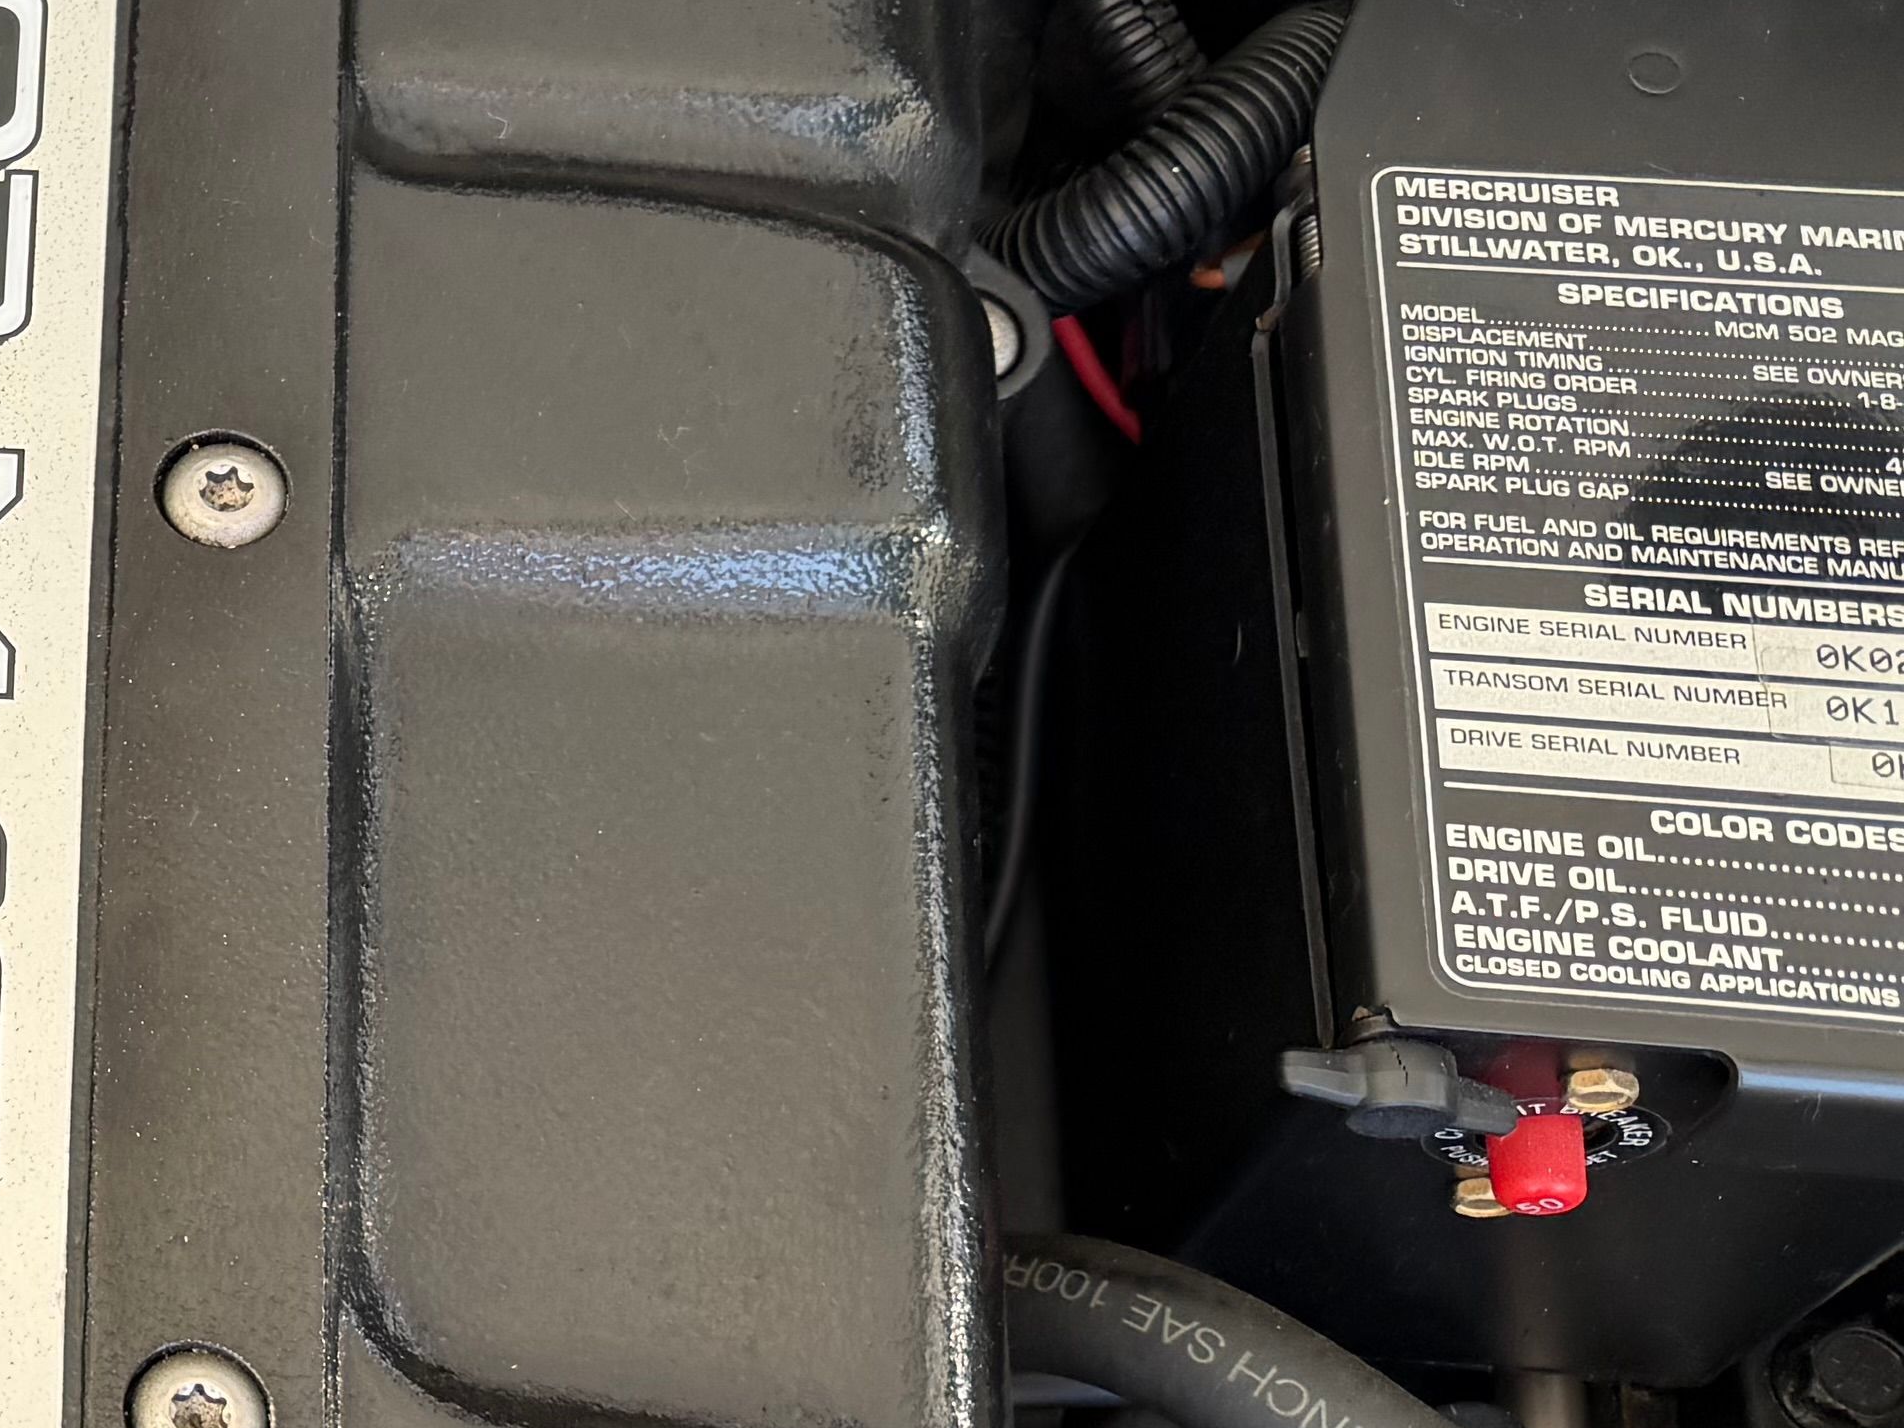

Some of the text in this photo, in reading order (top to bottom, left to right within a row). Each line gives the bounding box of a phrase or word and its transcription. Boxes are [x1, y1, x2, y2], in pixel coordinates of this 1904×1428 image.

[1395, 176, 1619, 207] MERCRUISER
[1397, 204, 1547, 232] DIVISION
[1558, 213, 1601, 234] OF
[1614, 215, 1787, 244] MERCURY
[1399, 233, 1822, 276] STILLWATER, OK., U.S.A.
[1558, 283, 1844, 319] SPECIFICATIONS
[1400, 304, 1904, 347] MODEL MCM 502 MAG
[1402, 325, 1587, 350] DISPLACEMENT
[1404, 346, 1904, 389] IGNITION TIMING SEE OWNER
[1406, 366, 1456, 384] CYL.
[1467, 369, 1546, 389] FIRING
[1553, 374, 1637, 395] ORDER
[1408, 387, 1577, 412] SPARK PLUGS
[1410, 408, 1629, 436] ENGINE ROTATION
[1412, 430, 1474, 448] MAX.
[1482, 433, 1563, 453] W.O.T.
[1573, 438, 1631, 458] RPM
[1413, 450, 1904, 497] IDLE RPM SEE OWNE
[1416, 472, 1629, 500] SPARK PLUG GAP
[1419, 511, 1467, 530] FOR
[1474, 514, 1535, 534] FUEL
[1543, 519, 1597, 539] AND
[1605, 522, 1644, 541] OIL
[1652, 525, 1851, 555] REQUIREMENTS
[1421, 532, 1559, 557] OPERATION
[1568, 542, 1622, 562] AND
[1631, 545, 1818, 574] MAINTENANCE
[1584, 584, 1904, 628] SERIAL NUMBERS
[1439, 614, 1530, 635] ENGINE
[1540, 621, 1626, 641] SERIAL
[1634, 627, 1747, 650] NUMBER
[1444, 669, 1568, 693] TRANSOM
[1579, 679, 1665, 700] SERIAL
[1674, 686, 1787, 709] NUMBER
[1451, 728, 1522, 748] DRIVE
[1532, 734, 1618, 756] SERIAL
[1627, 741, 1740, 765] NUMBER
[1446, 823, 1656, 863] ENGINE OIL
[1650, 810, 1904, 852] COLOR CODES
[1448, 856, 1627, 893] DRIVE OIL
[1451, 890, 1767, 938] A.T.F./P.S. FLUID
[1454, 924, 1783, 973] ENGINE COOLANT
[1456, 954, 1900, 1008] CLOSED COOLING APPLICATIONS
[1516, 1197, 1564, 1215] 50
[1002, 1254, 1109, 1308] 100R
[1122, 1292, 1227, 1365] SAE
